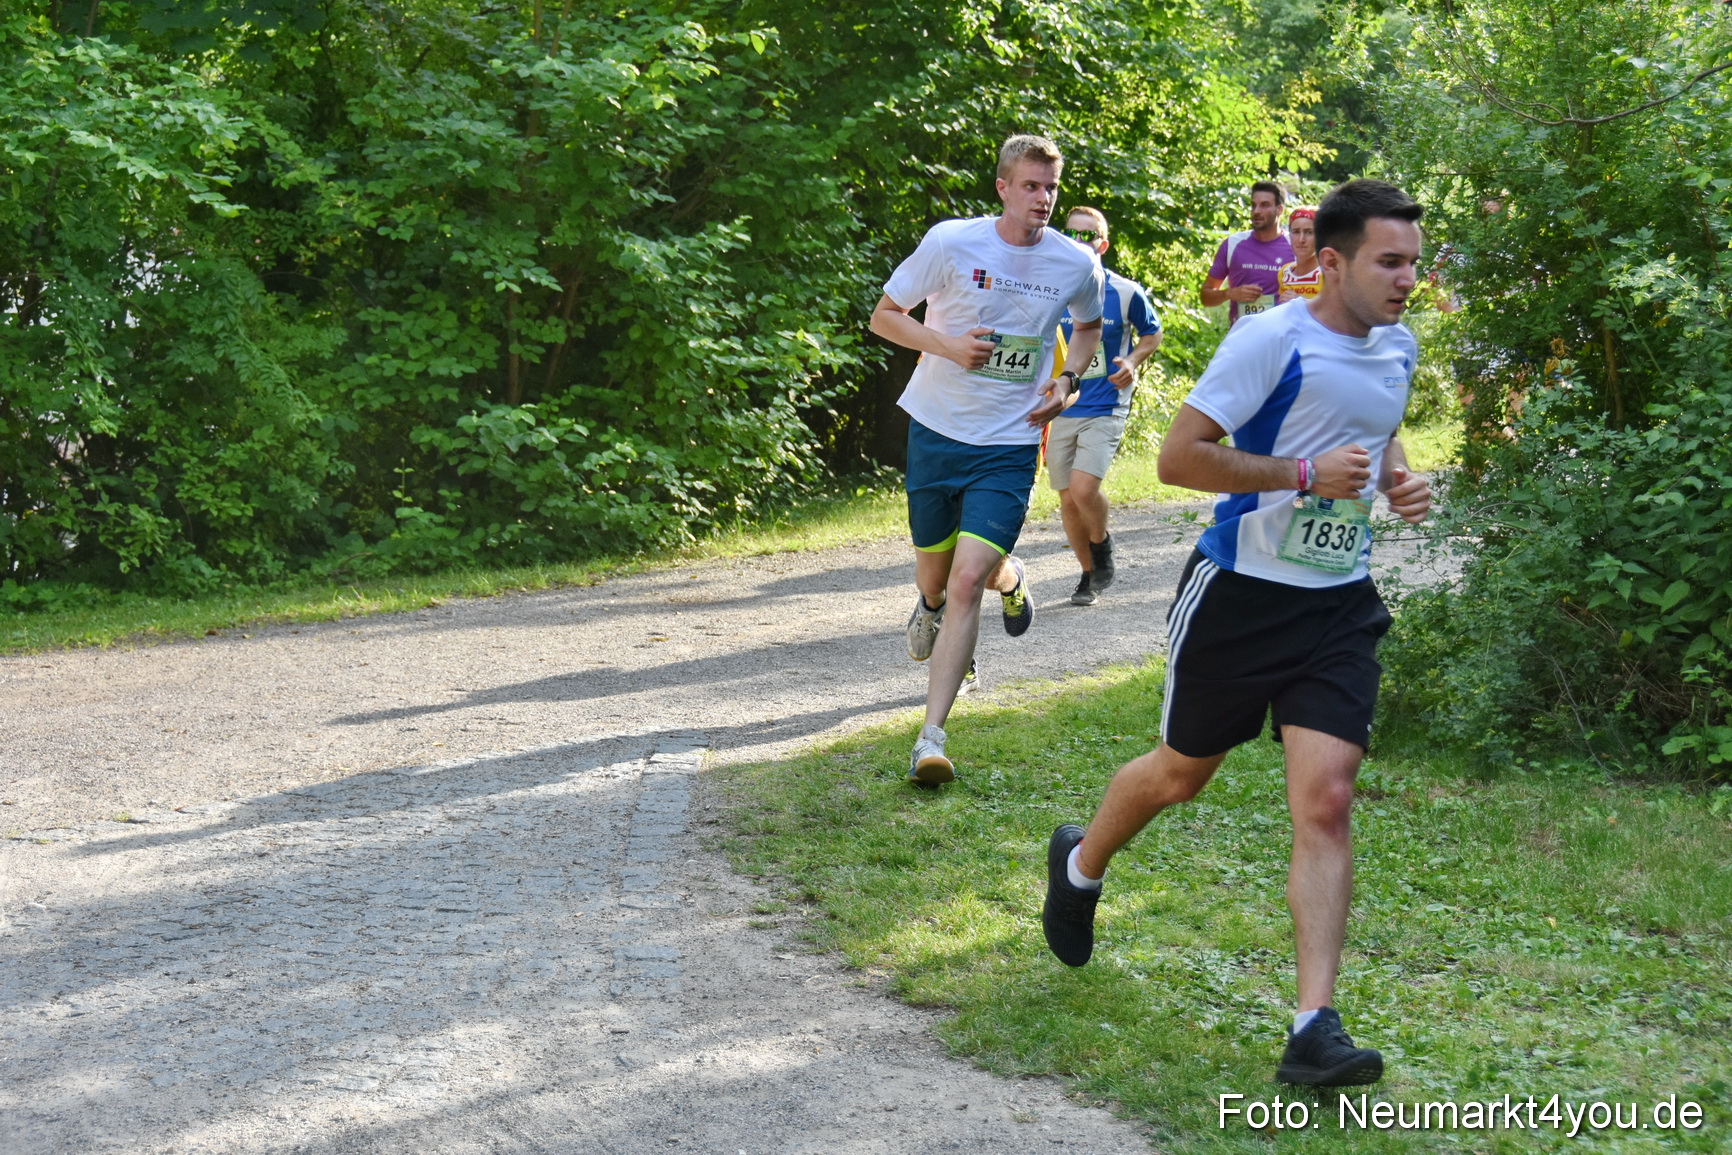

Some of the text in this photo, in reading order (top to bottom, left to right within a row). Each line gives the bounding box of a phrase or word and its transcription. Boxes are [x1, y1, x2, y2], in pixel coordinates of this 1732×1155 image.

[994, 287, 1028, 296] COMPUTER
[995, 278, 1060, 296] SCHWARZ
[986, 350, 1030, 370] 144
[1301, 518, 1358, 553] 1838
